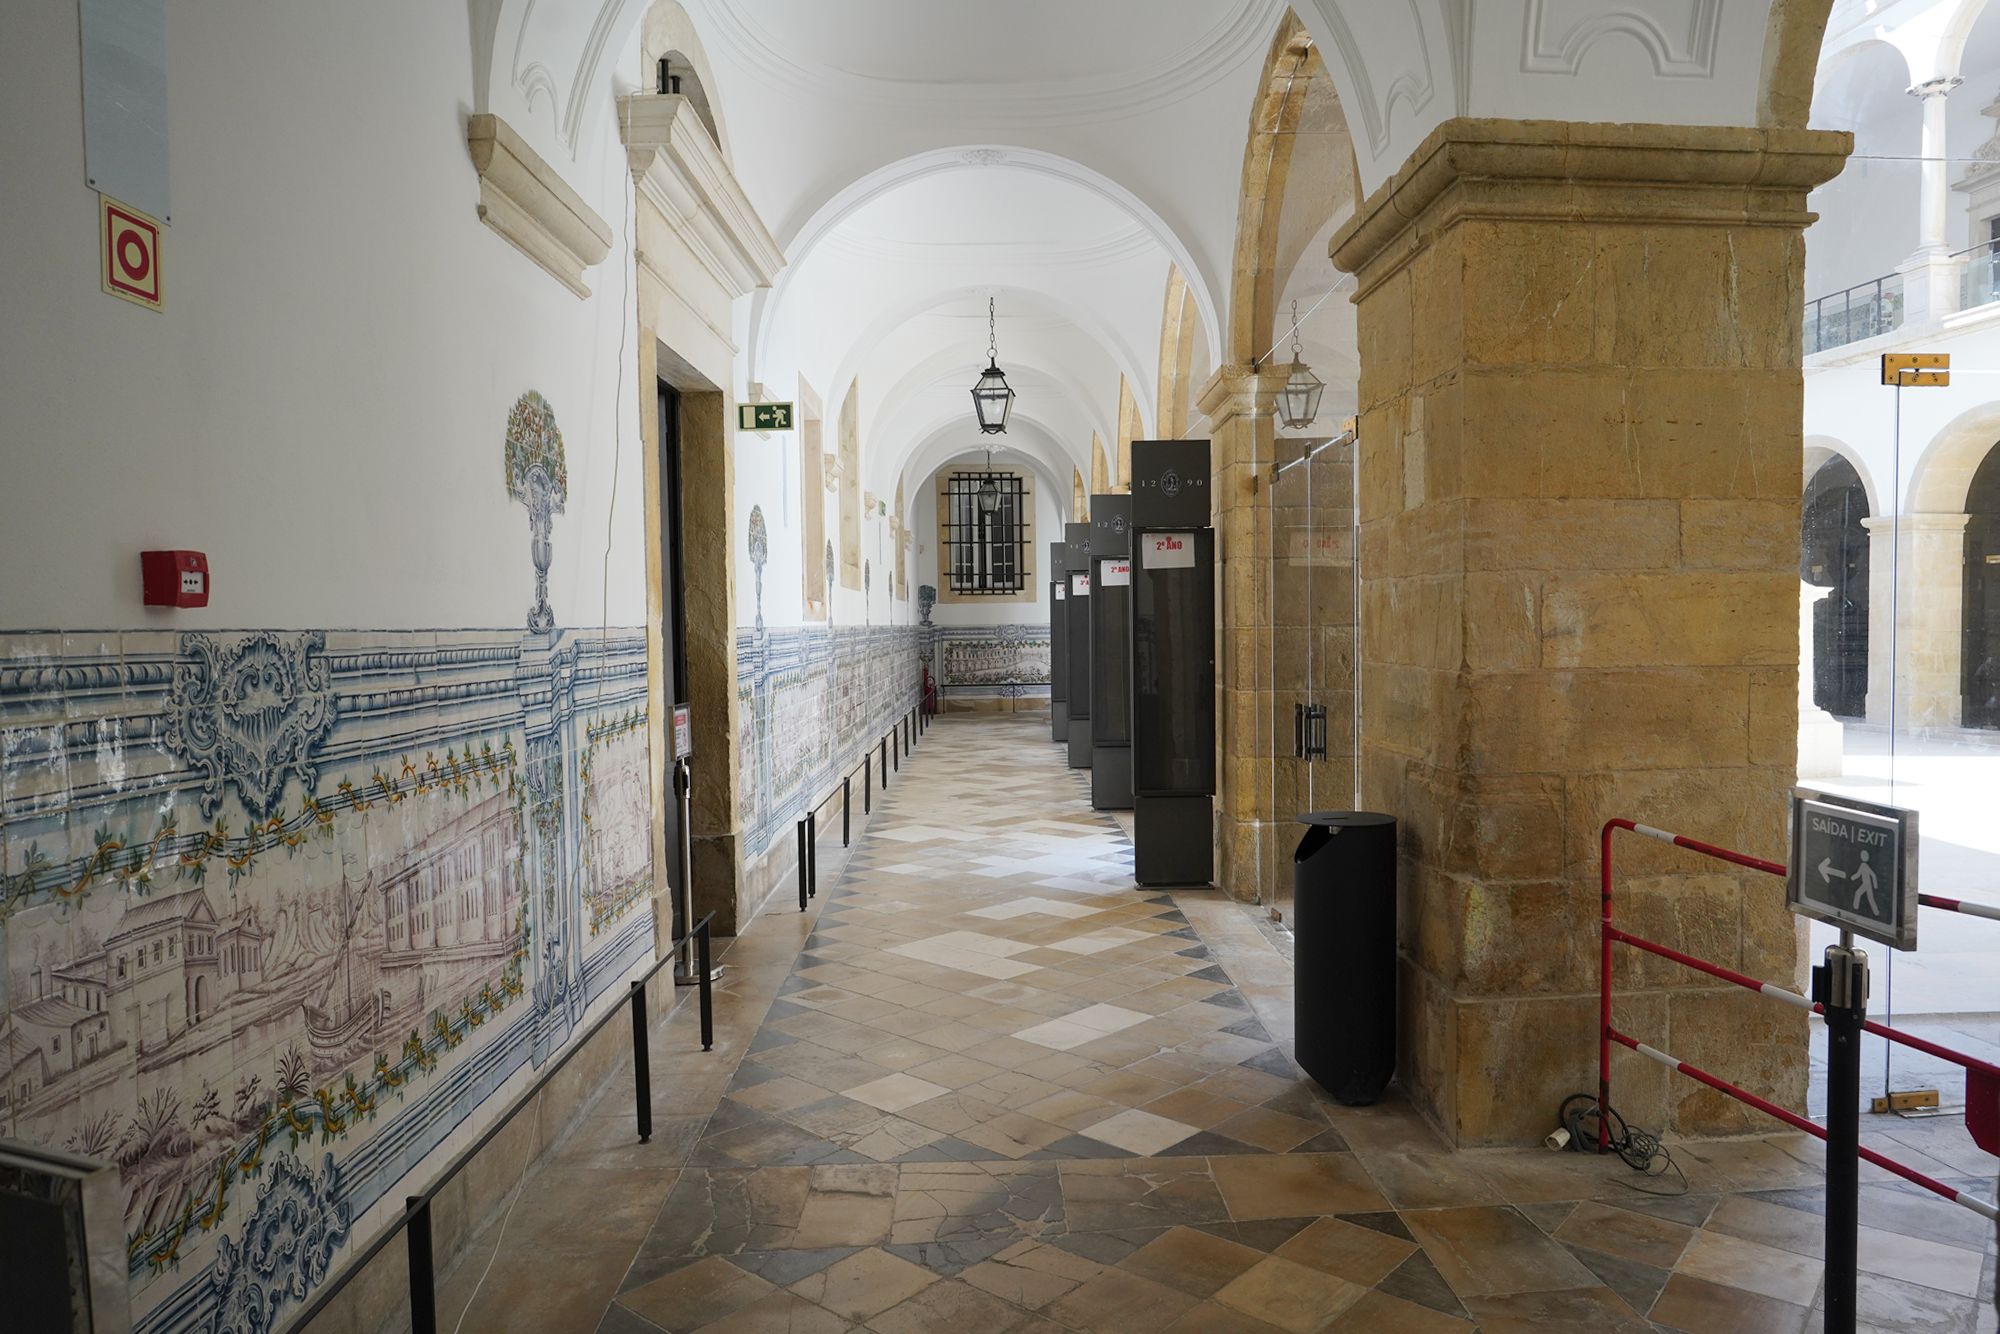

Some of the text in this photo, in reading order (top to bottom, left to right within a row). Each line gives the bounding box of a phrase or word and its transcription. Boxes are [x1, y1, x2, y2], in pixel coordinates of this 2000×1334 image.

[1166, 540, 1183, 550] ANO
[1812, 817, 1848, 839] SAÍDA
[1857, 828, 1888, 847] EXIT
